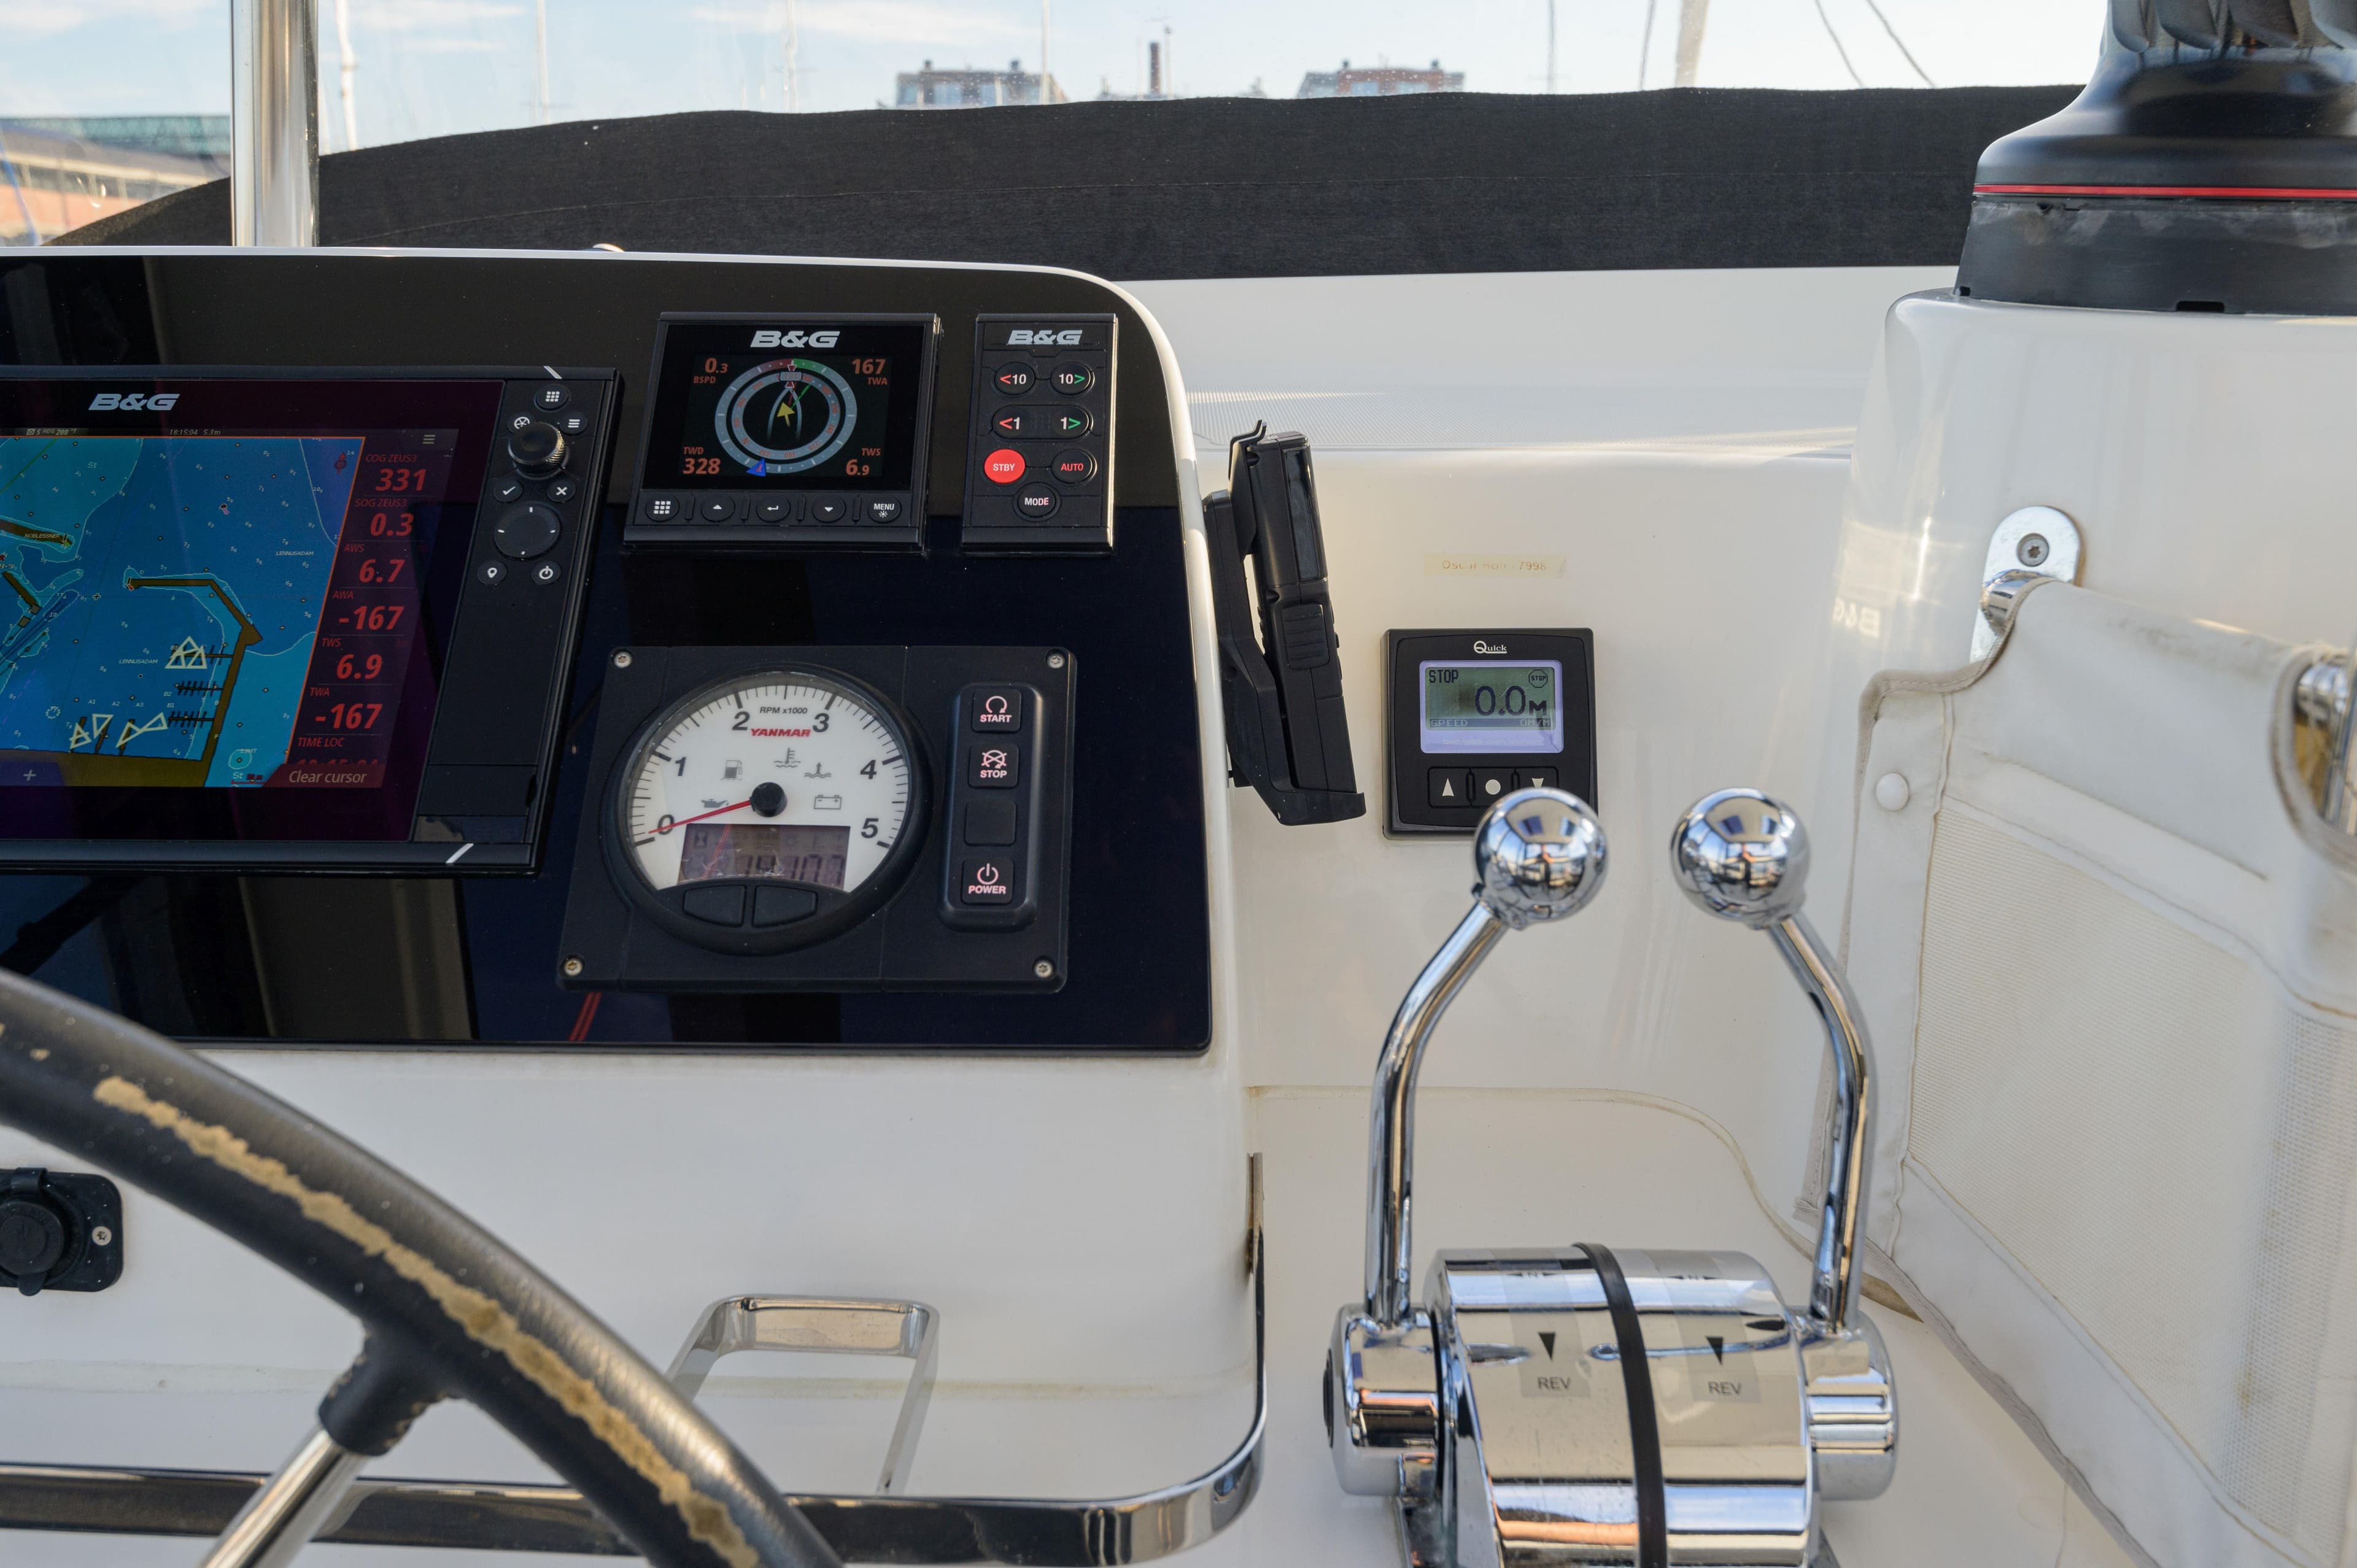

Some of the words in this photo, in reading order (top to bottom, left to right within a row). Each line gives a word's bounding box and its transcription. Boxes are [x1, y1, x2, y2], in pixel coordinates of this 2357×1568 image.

[750, 331, 840, 348] B&G
[1007, 330, 1083, 345] B&G
[705, 358, 729, 374] 0.3
[853, 359, 886, 374] 167
[693, 376, 716, 384] BSPD
[867, 377, 888, 385] TWA
[88, 393, 180, 411] B&G
[683, 458, 721, 474] 328
[845, 459, 869, 476] 6.9
[375, 468, 427, 491] 331
[354, 498, 376, 507] SOG
[377, 498, 407, 507] ZEUS3
[370, 512, 414, 536] 0.3
[344, 544, 365, 552] AWS
[359, 559, 405, 582] 6.7
[332, 590, 354, 599] AWA
[339, 606, 404, 630] -167
[322, 638, 341, 647] TWS
[1474, 640, 1507, 654] Quick
[336, 654, 382, 679] 6.9
[1428, 670, 1459, 684] STOP
[310, 687, 330, 697] TWA
[1476, 686, 1525, 716] 0.0
[1529, 701, 1547, 716] M
[315, 703, 383, 729] -167
[732, 711, 750, 731] 2
[812, 713, 829, 733] 3
[980, 714, 1012, 723] START
[751, 728, 811, 737] YANMAR
[298, 738, 323, 747] TIME
[324, 737, 345, 747] LOC
[675, 757, 687, 777] 1
[860, 760, 877, 780] 4
[289, 770, 323, 783] Clear
[325, 773, 367, 783] cursor
[657, 814, 675, 835] 0
[861, 817, 879, 839] 5
[968, 886, 1006, 894] POWER
[1538, 1377, 1571, 1390] REV
[1708, 1381, 1742, 1395] REV
